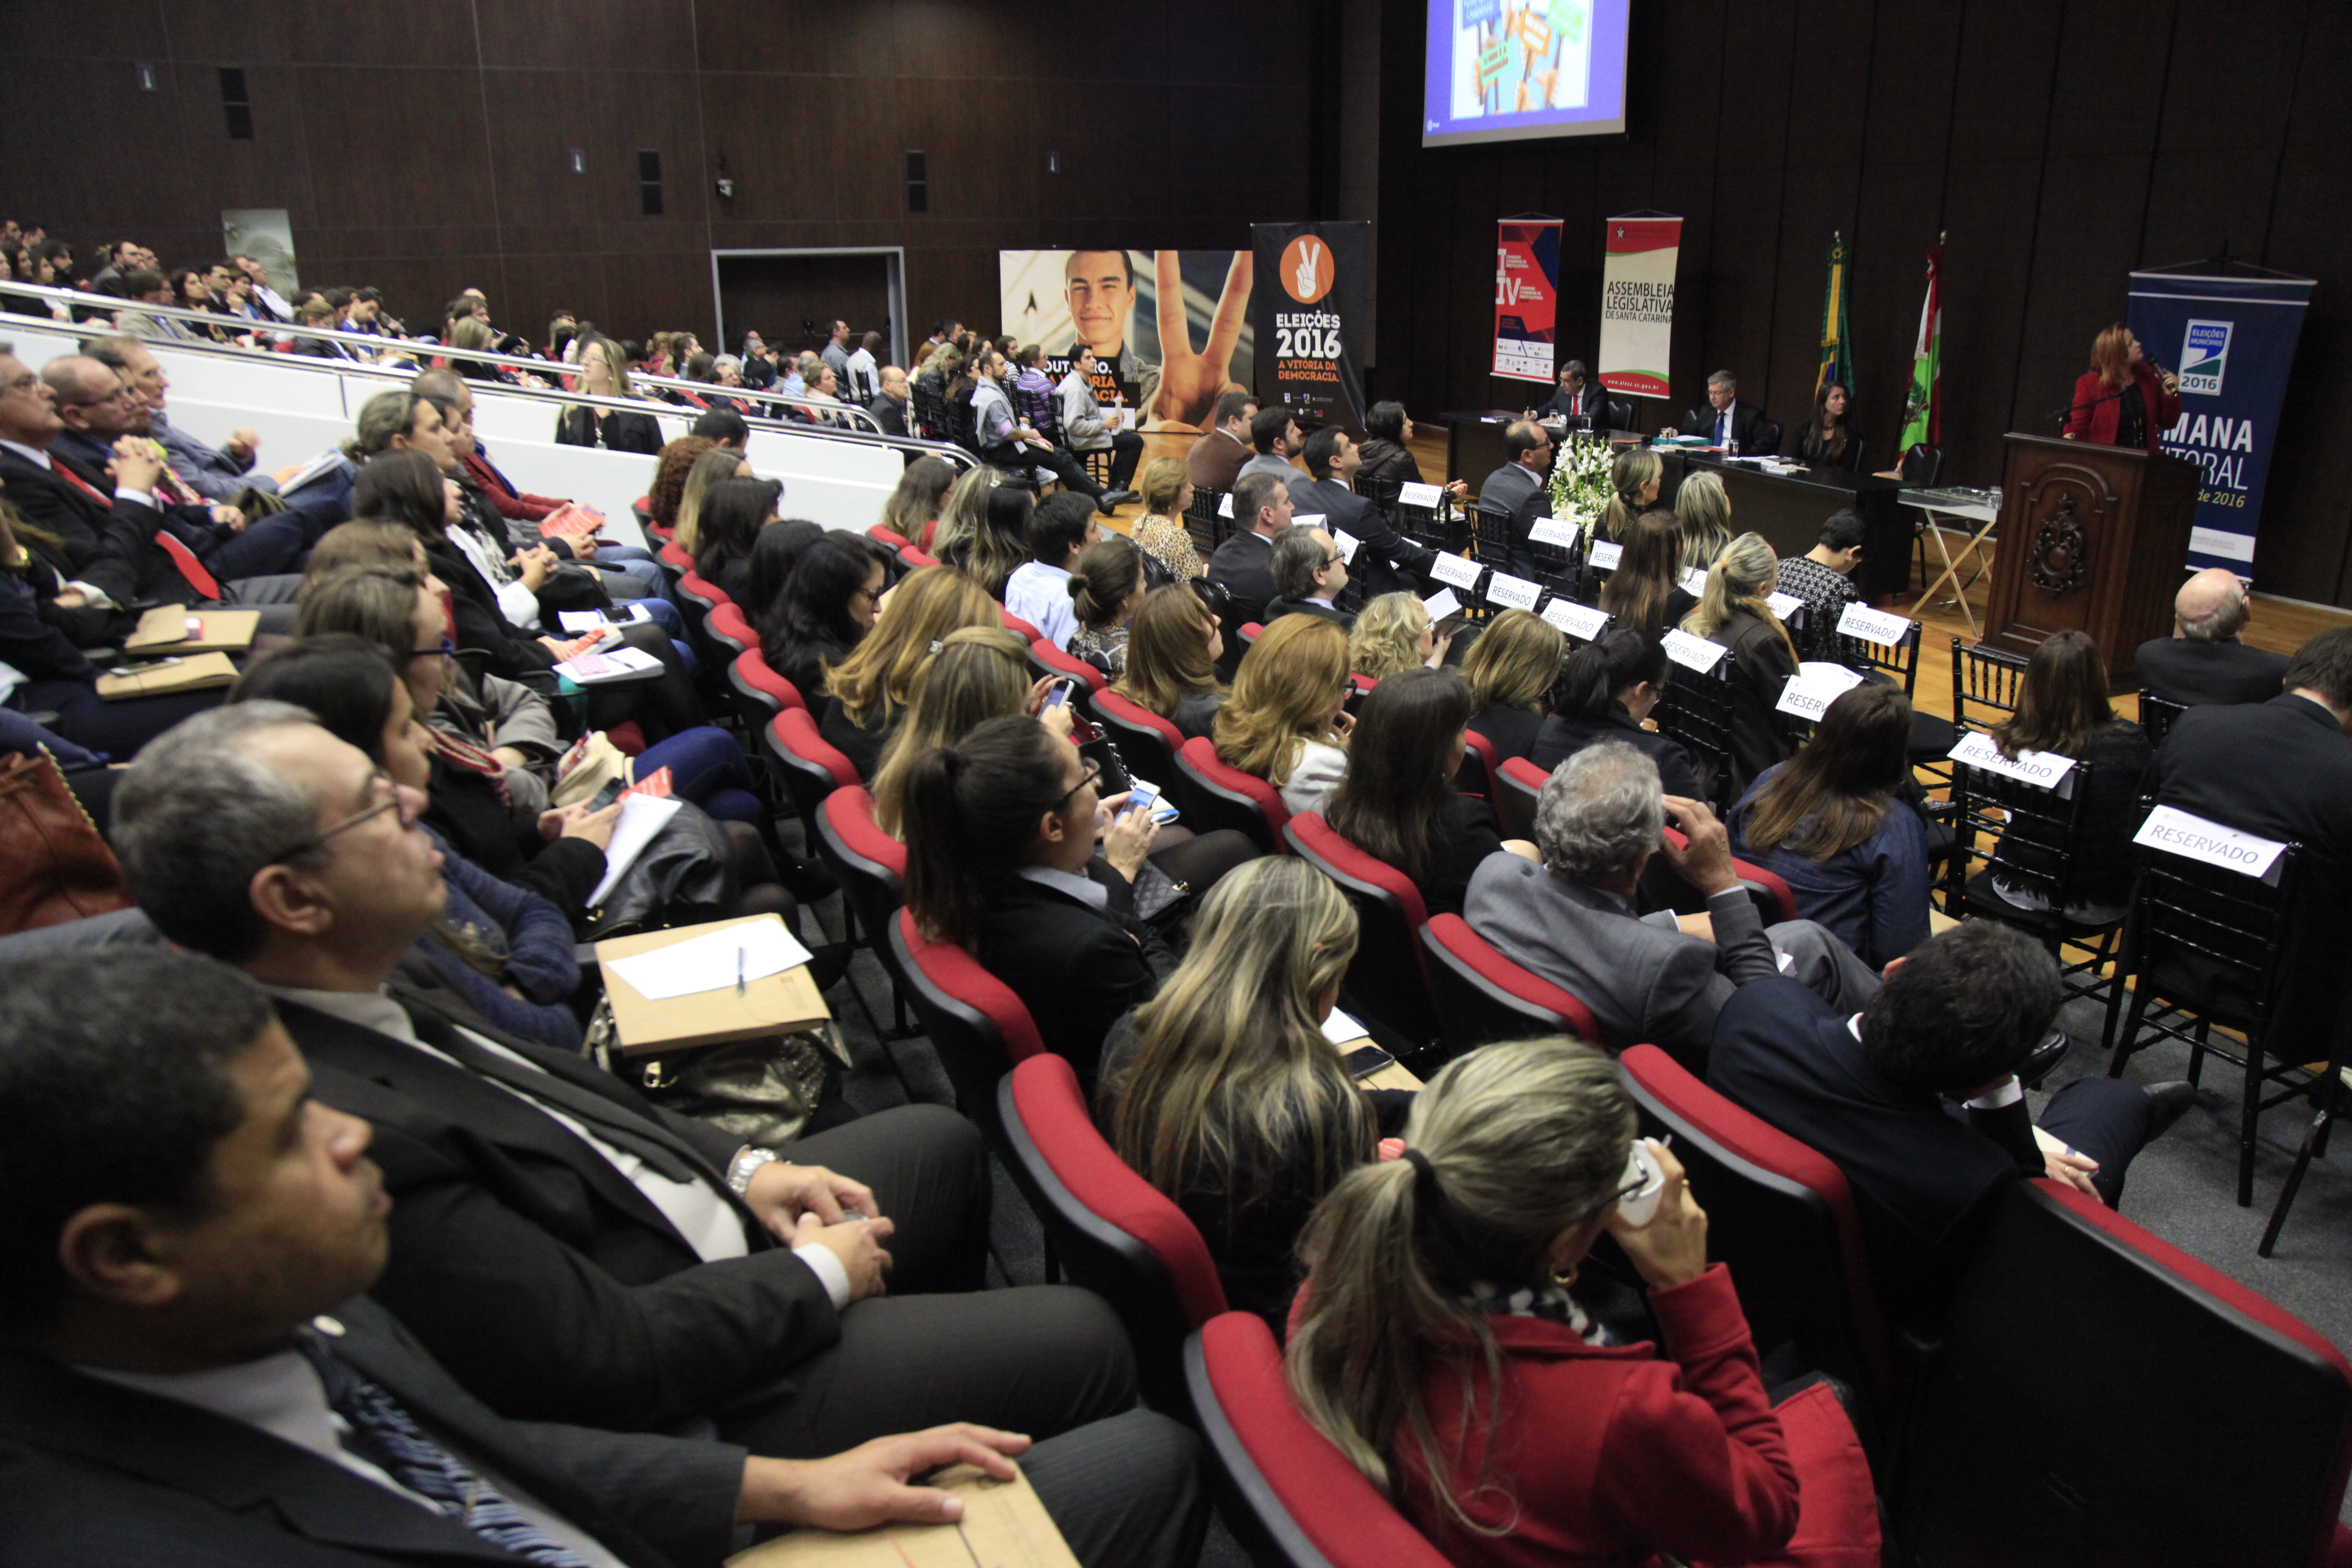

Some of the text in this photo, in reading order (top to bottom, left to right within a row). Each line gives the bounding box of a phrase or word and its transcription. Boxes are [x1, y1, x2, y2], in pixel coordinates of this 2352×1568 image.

[1495, 276, 1522, 306] IV
[1607, 281, 1674, 298] ASSEMBLEIA
[1607, 295, 1673, 313] LEGISLATIVA
[1276, 309, 1341, 332] ELEIÇÕES
[1605, 310, 1672, 324] DE SANTA CATARINA
[2192, 328, 2226, 338] ELEIÇÕES
[1276, 328, 1341, 359] 2016
[2190, 338, 2223, 347] MUNICIPAIS
[1278, 357, 1337, 371] A VITÓRIA DA
[1278, 370, 1340, 382] DEMOCRACIA.
[1607, 379, 1659, 390] www.alesc.sc.gov.br
[2181, 376, 2217, 390] 2016
[1404, 491, 1436, 503] RESERVADO
[2212, 491, 2246, 508] 2016
[1534, 527, 1571, 542] RESERVADO
[1436, 563, 1472, 583] RESERVADO
[1492, 585, 1531, 606] RESERVADO
[1545, 611, 1594, 632] RESERVADO
[1844, 617, 1896, 639] RESERVADO
[1663, 640, 1711, 665] RESERVADO
[1786, 692, 1827, 714] RESERV
[2150, 824, 2259, 864] RESERVADO
